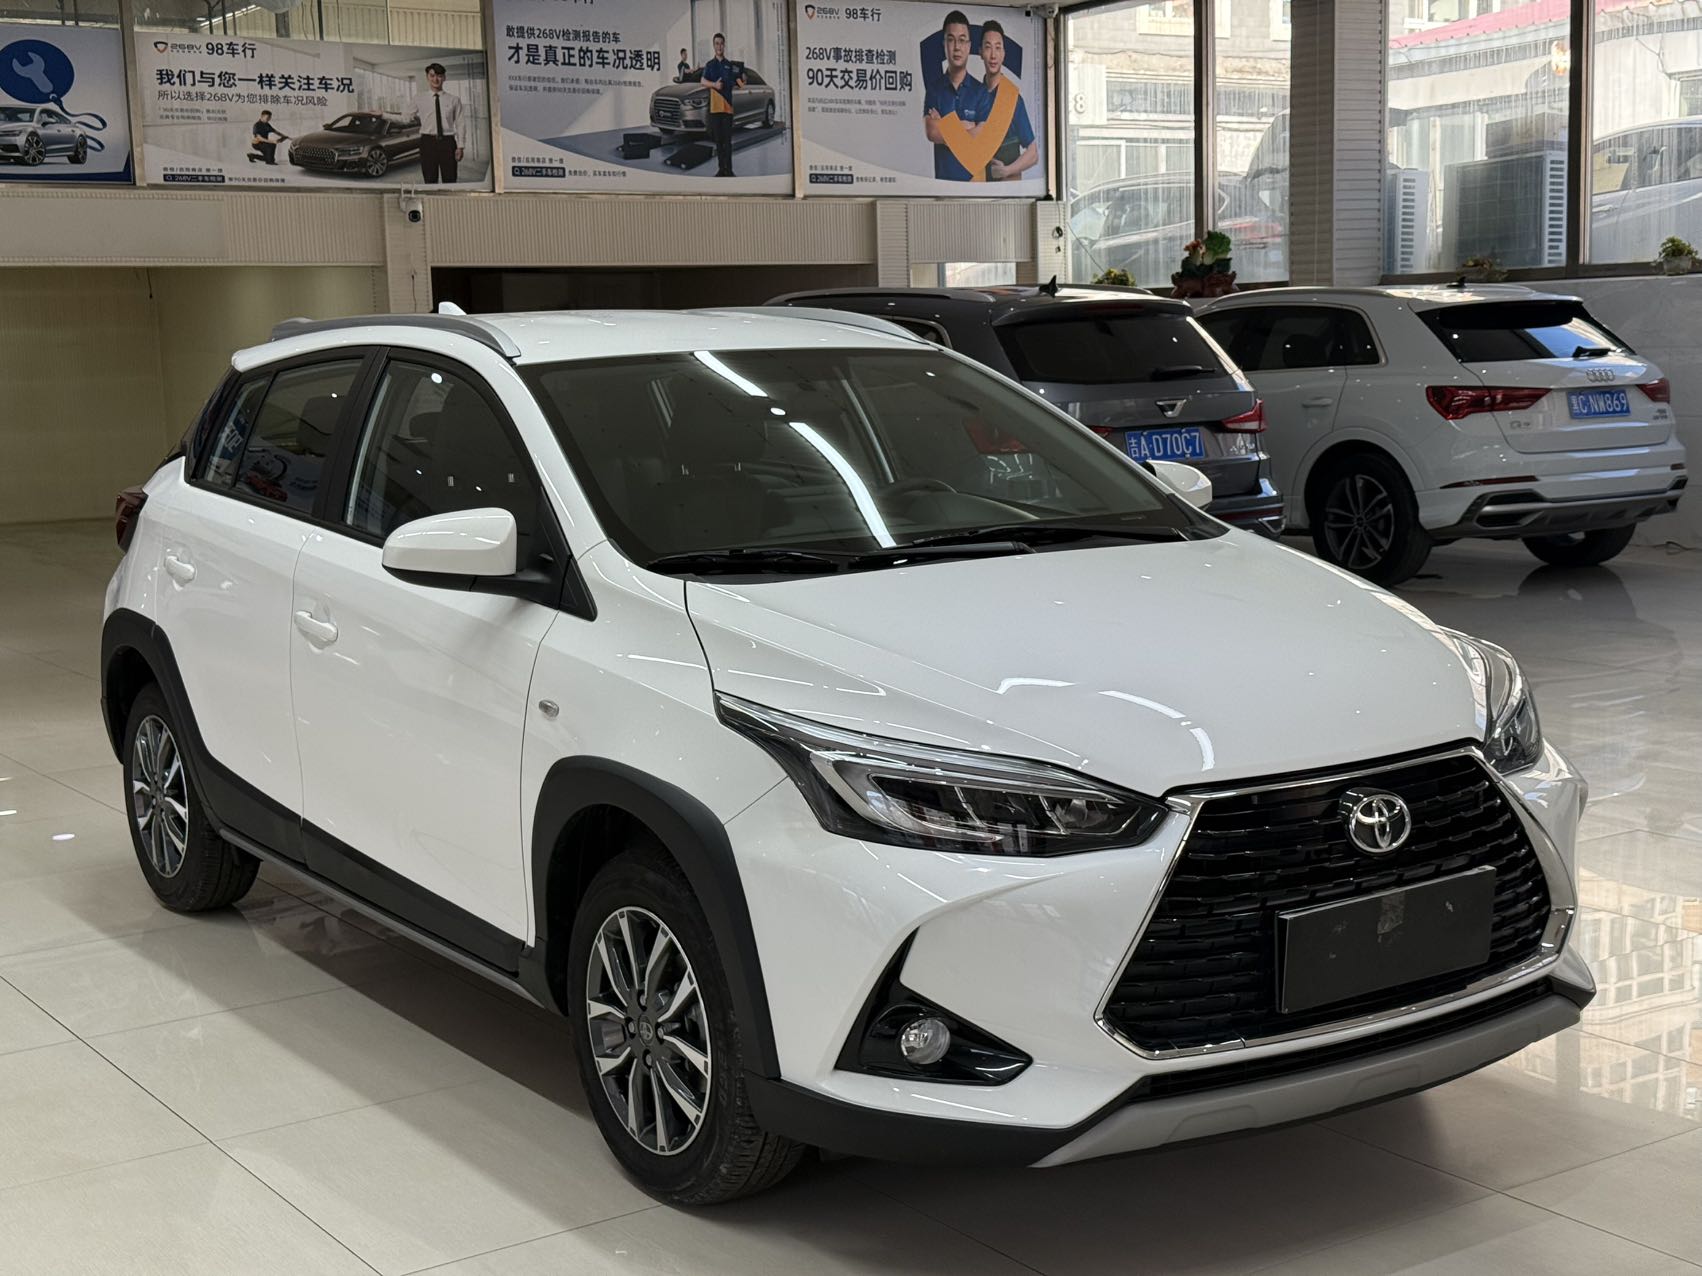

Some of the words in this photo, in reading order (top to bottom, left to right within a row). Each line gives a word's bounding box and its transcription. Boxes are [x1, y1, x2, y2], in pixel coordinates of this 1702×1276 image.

[844, 7, 882, 21] 98车行
[506, 25, 621, 44] 敢提供268V检测报告的车
[206, 42, 256, 58] 98车行
[507, 42, 661, 72] 才是真正的车况透明
[805, 46, 897, 66] 268V事故排查检测
[155, 68, 354, 93] 我们与您一样关注车况
[806, 68, 913, 92] 90天交易价回购
[157, 90, 329, 107] 所以选择268V为您排除车况风险
